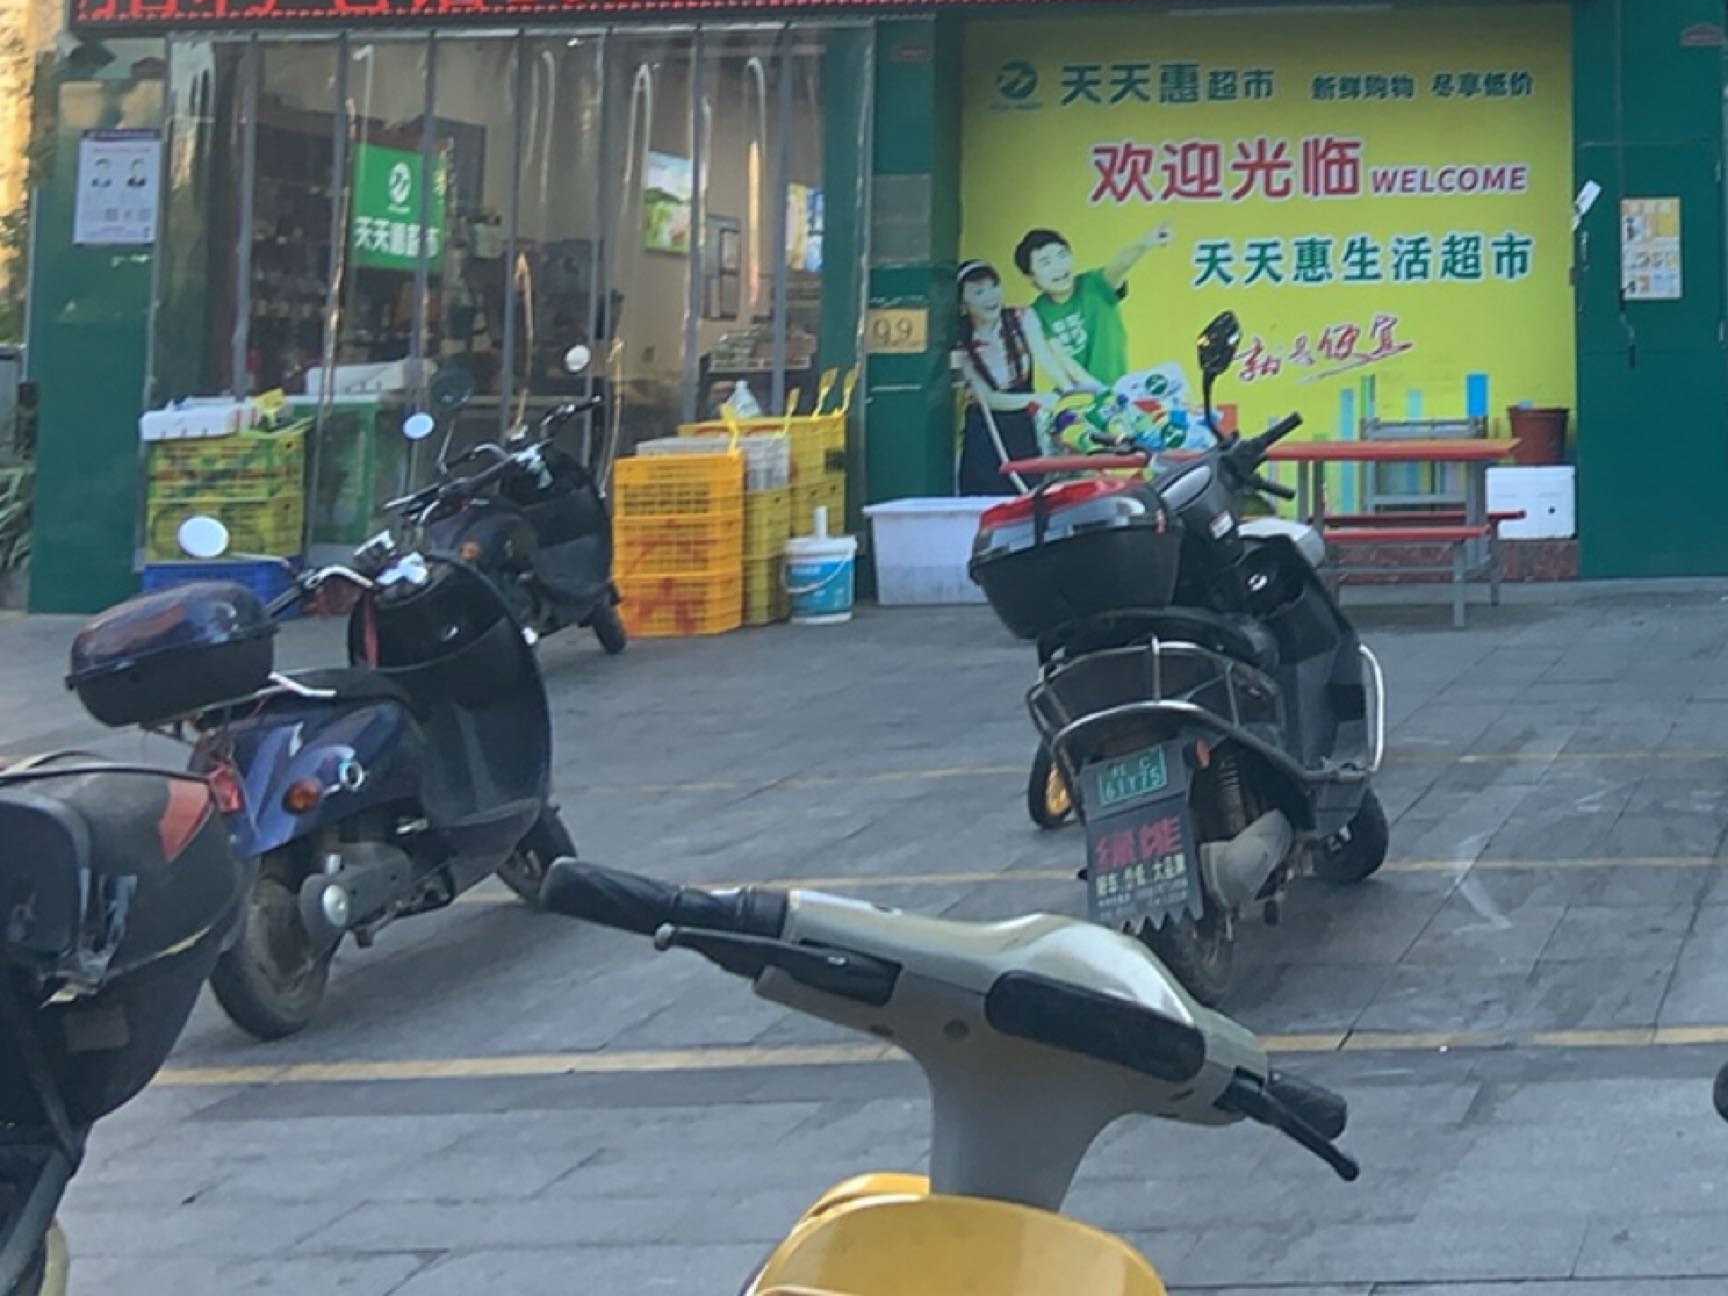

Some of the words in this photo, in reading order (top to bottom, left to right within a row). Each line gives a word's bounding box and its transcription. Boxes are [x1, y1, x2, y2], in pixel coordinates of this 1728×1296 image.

[1060, 62, 1274, 106] 天天惠超市
[1090, 136, 1364, 204] 欢迎光临
[1370, 164, 1529, 195] WELCOME
[1193, 232, 1535, 288] 天天惠生活超市
